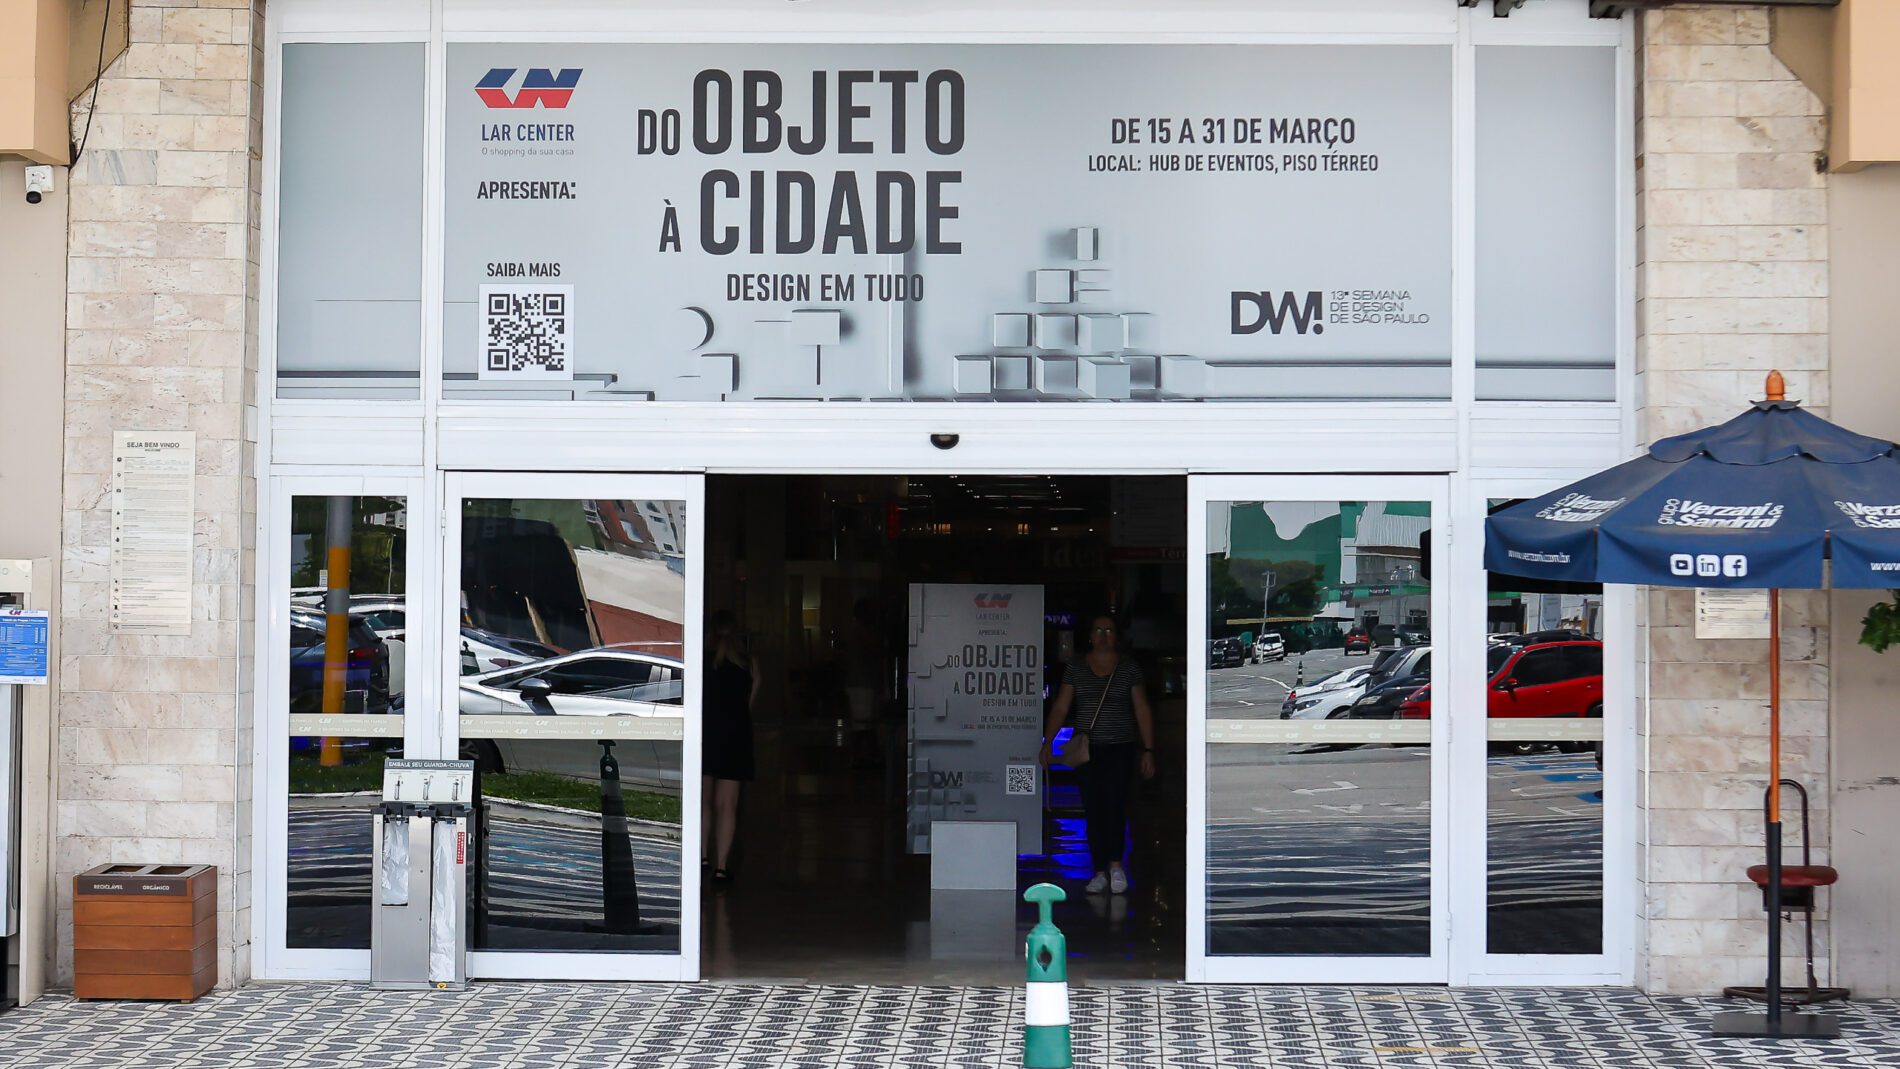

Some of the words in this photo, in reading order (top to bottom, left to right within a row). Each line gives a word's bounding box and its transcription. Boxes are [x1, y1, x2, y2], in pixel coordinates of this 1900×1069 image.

[637, 108, 681, 156] DO
[693, 69, 966, 155] OBJETO
[482, 124, 511, 141] LAR
[517, 124, 575, 141] CENTER
[1111, 118, 1141, 144] DE
[1147, 118, 1172, 144] 15
[1178, 118, 1195, 144] A
[1202, 118, 1226, 144] 31
[1234, 118, 1262, 144] DE
[1269, 118, 1356, 149] MARÇO
[490, 147, 526, 157] shopping
[527, 147, 537, 156] da
[539, 148, 554, 156] sua
[556, 148, 574, 156] casa
[1088, 155, 1142, 172] LOCAL:
[1149, 155, 1180, 172] HUB
[1185, 155, 1204, 172] DE
[1208, 155, 1279, 174] EVENTOS,
[1283, 155, 1317, 171] PISO
[1322, 150, 1379, 172] TÉRREO
[477, 181, 576, 199] APRESENTA:
[658, 199, 682, 253] À
[700, 169, 963, 256] CIDADE
[487, 262, 525, 278] SAIBA
[528, 262, 561, 278] MAIS
[727, 273, 811, 303] DESIGN
[820, 274, 855, 302] EM
[867, 273, 924, 302] TUDO
[1352, 290, 1412, 300] SEMANA
[1231, 291, 1324, 335] DW!
[1330, 302, 1349, 311] DE
[1352, 302, 1404, 312] DESIGN
[1330, 314, 1349, 323] DE
[1352, 311, 1381, 323] SÃO
[1384, 314, 1430, 323] PAULO
[1679, 500, 1773, 516] Verzani
[1768, 504, 1785, 516] &
[1675, 513, 1781, 528] Sandrini
[947, 655, 960, 668] DO
[962, 644, 1037, 668] OBJETO
[964, 671, 1036, 695] CIDADE
